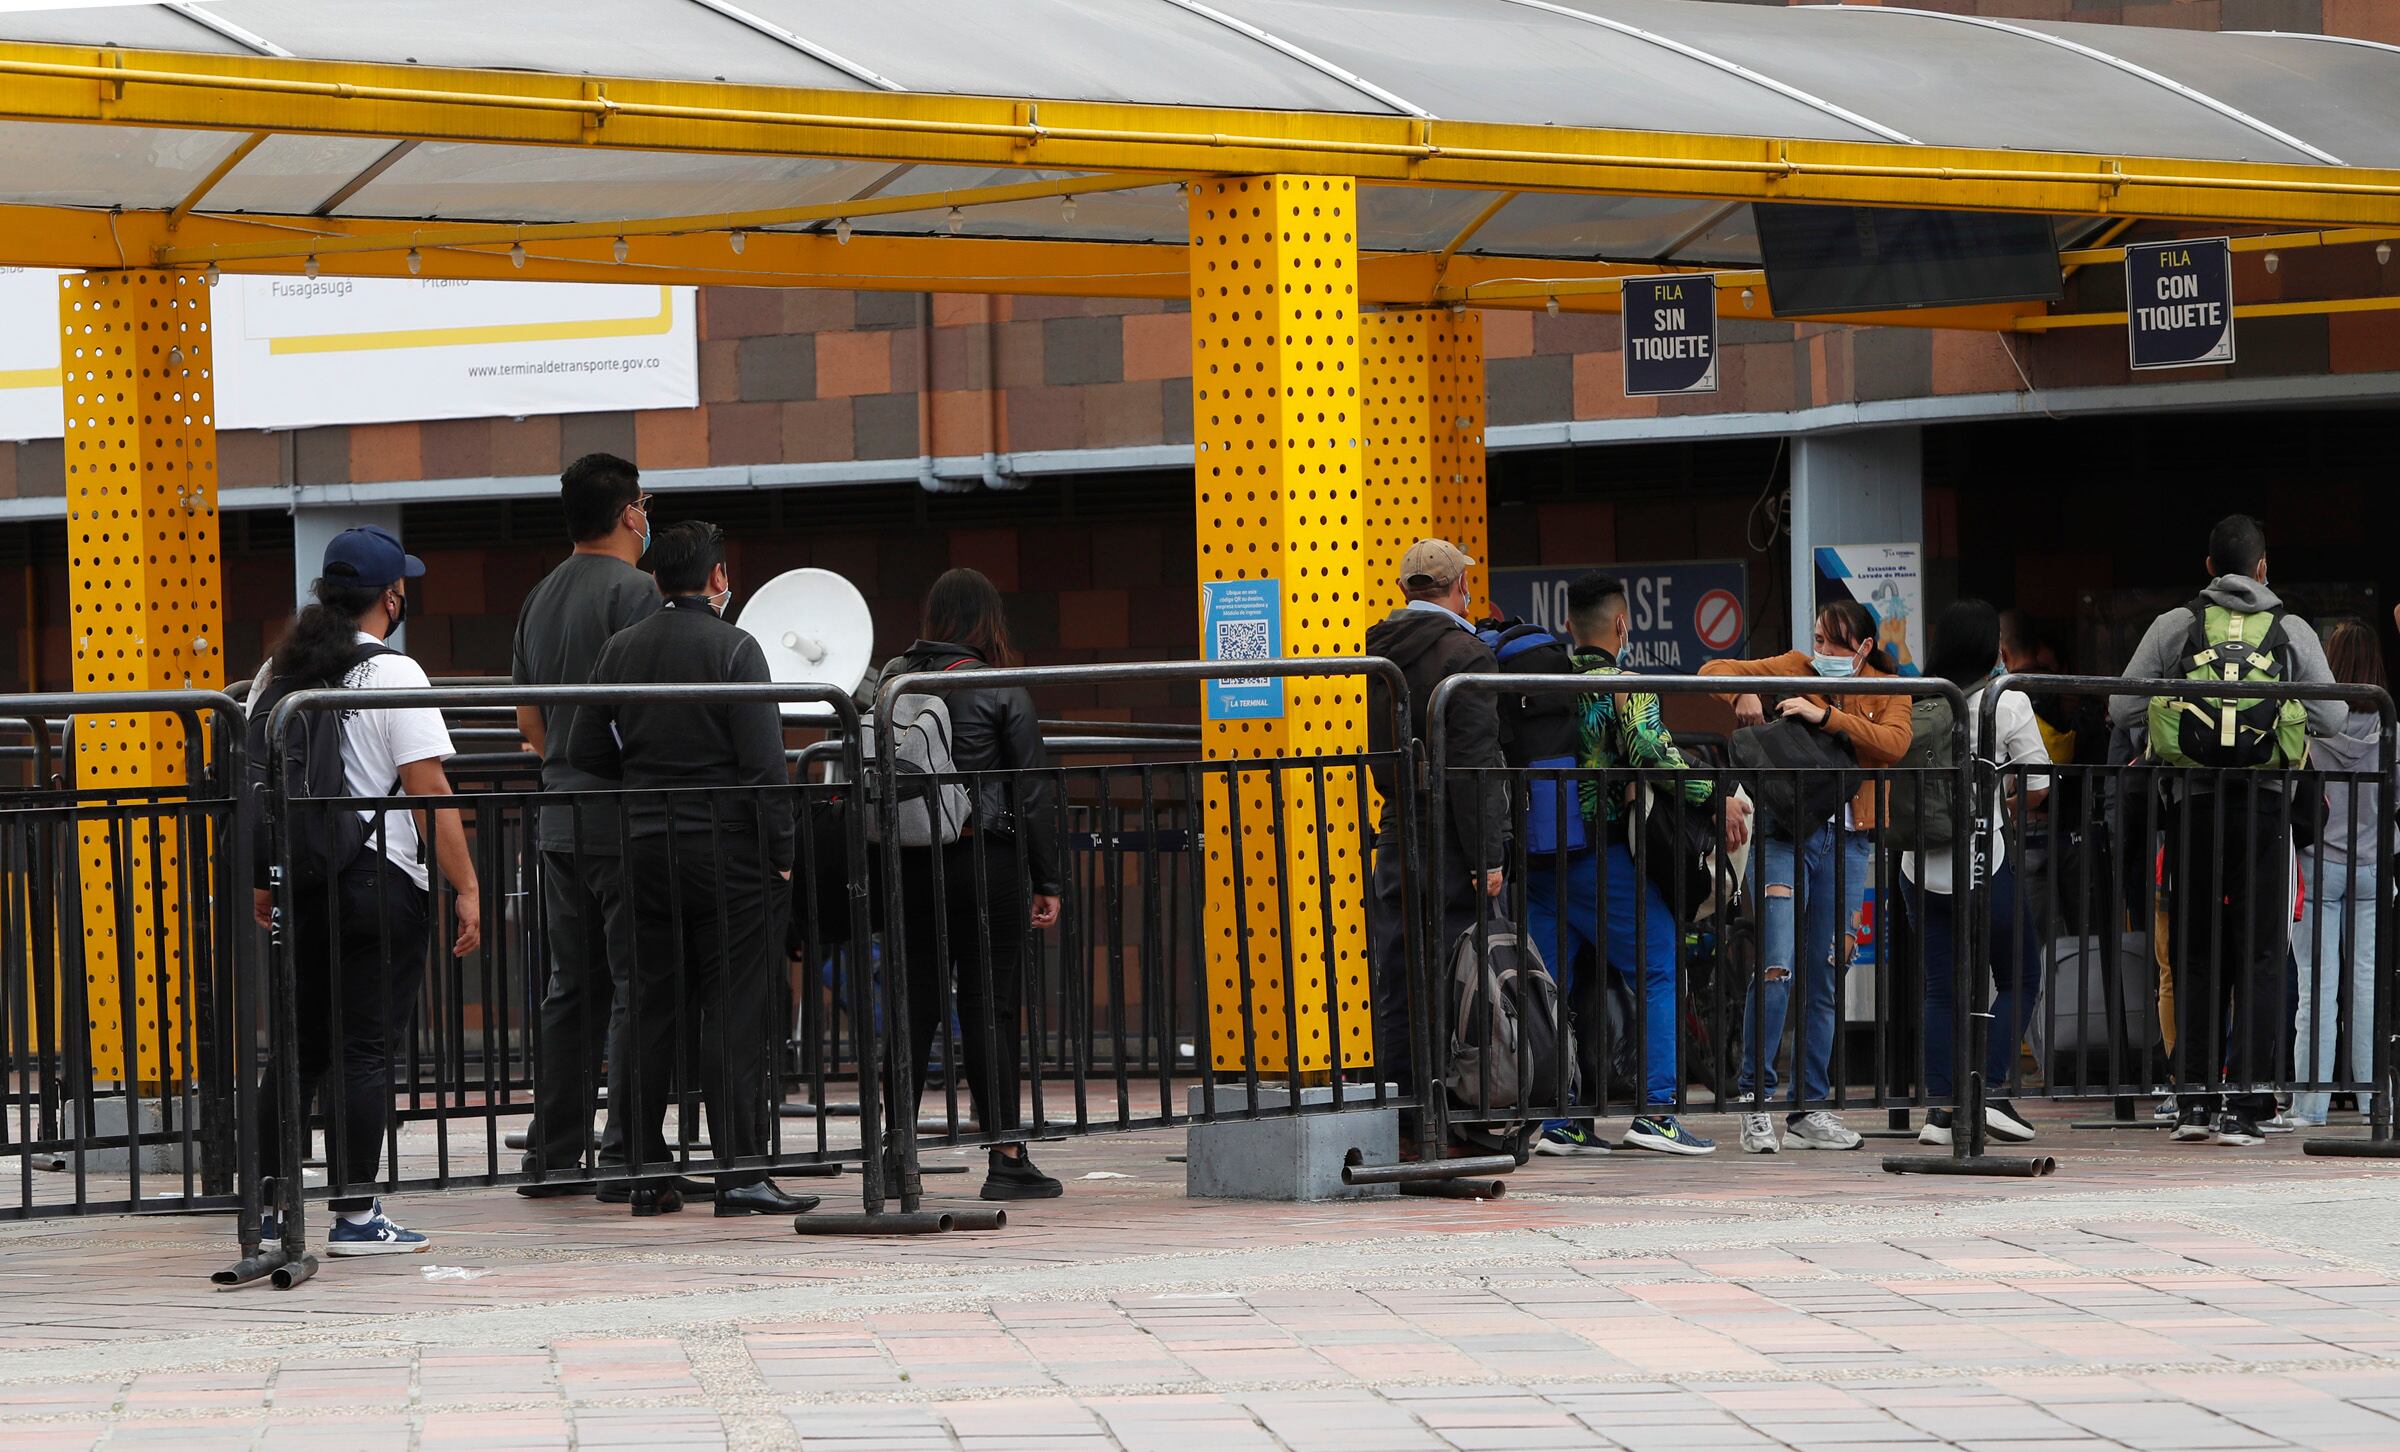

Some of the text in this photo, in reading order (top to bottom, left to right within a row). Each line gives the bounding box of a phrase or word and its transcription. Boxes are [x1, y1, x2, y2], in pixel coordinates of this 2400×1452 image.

[2159, 250, 2191, 268] FILA
[272, 277, 353, 299] Fusagasugá
[1654, 284, 1683, 301] FILA
[2157, 274, 2198, 300] CON
[1654, 308, 1685, 331] SIN
[2137, 302, 2222, 331] TIQUETE
[1632, 335, 1709, 361] TIQUETE
[468, 357, 660, 377] www.terminaldetransporte.gov.co
[1531, 579, 1568, 634] NO
[1625, 640, 1681, 667] SALIDA
[1240, 699, 1268, 707] TERMINAL
